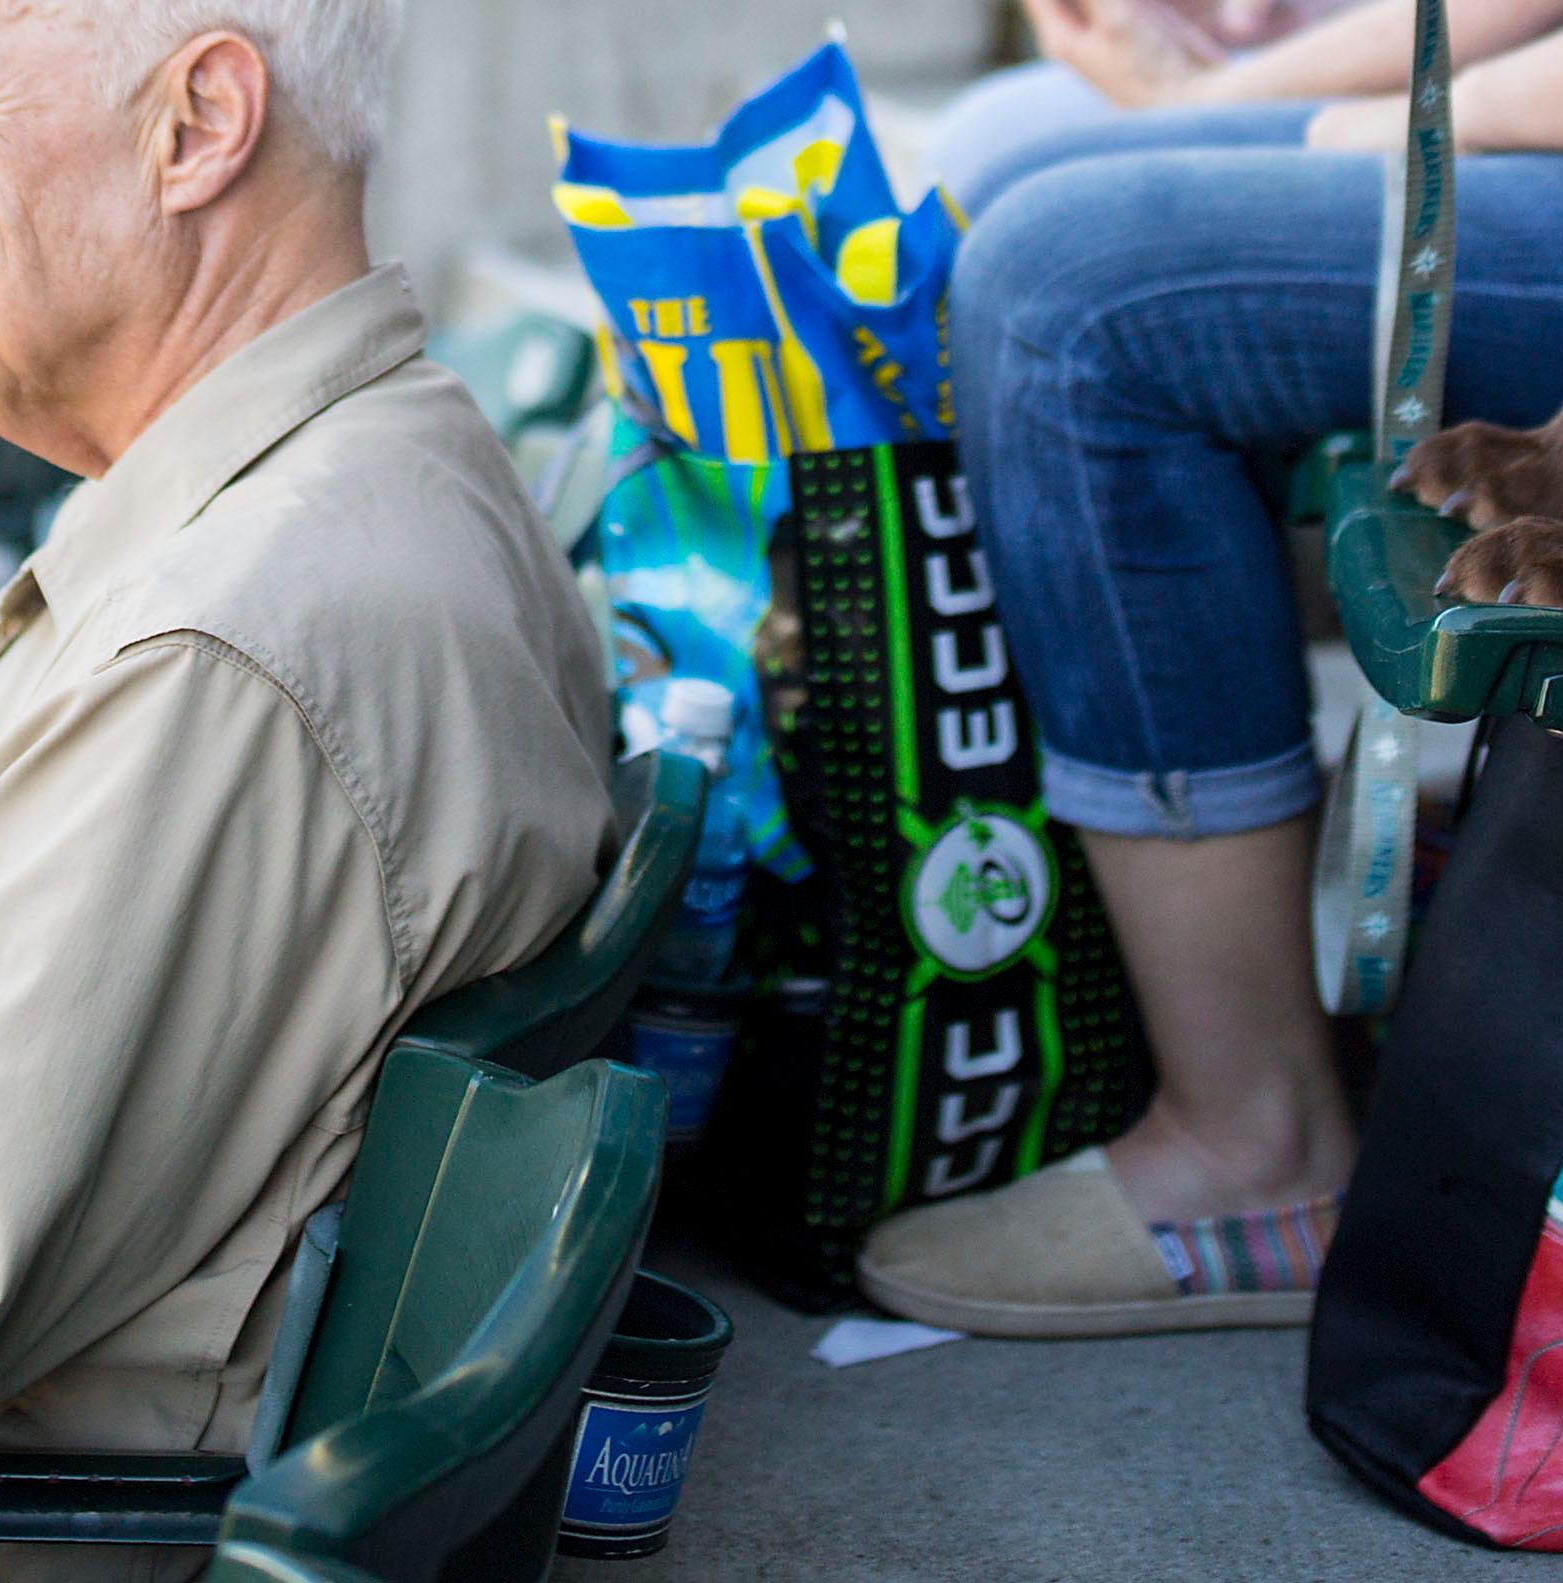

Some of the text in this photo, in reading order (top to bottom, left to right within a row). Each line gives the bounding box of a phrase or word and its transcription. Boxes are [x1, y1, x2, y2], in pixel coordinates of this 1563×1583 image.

[628, 295, 711, 338] THE
[913, 476, 1018, 771] ECCC
[924, 1008, 1022, 1197] CCC
[584, 1432, 694, 1495] AQUAFINA
